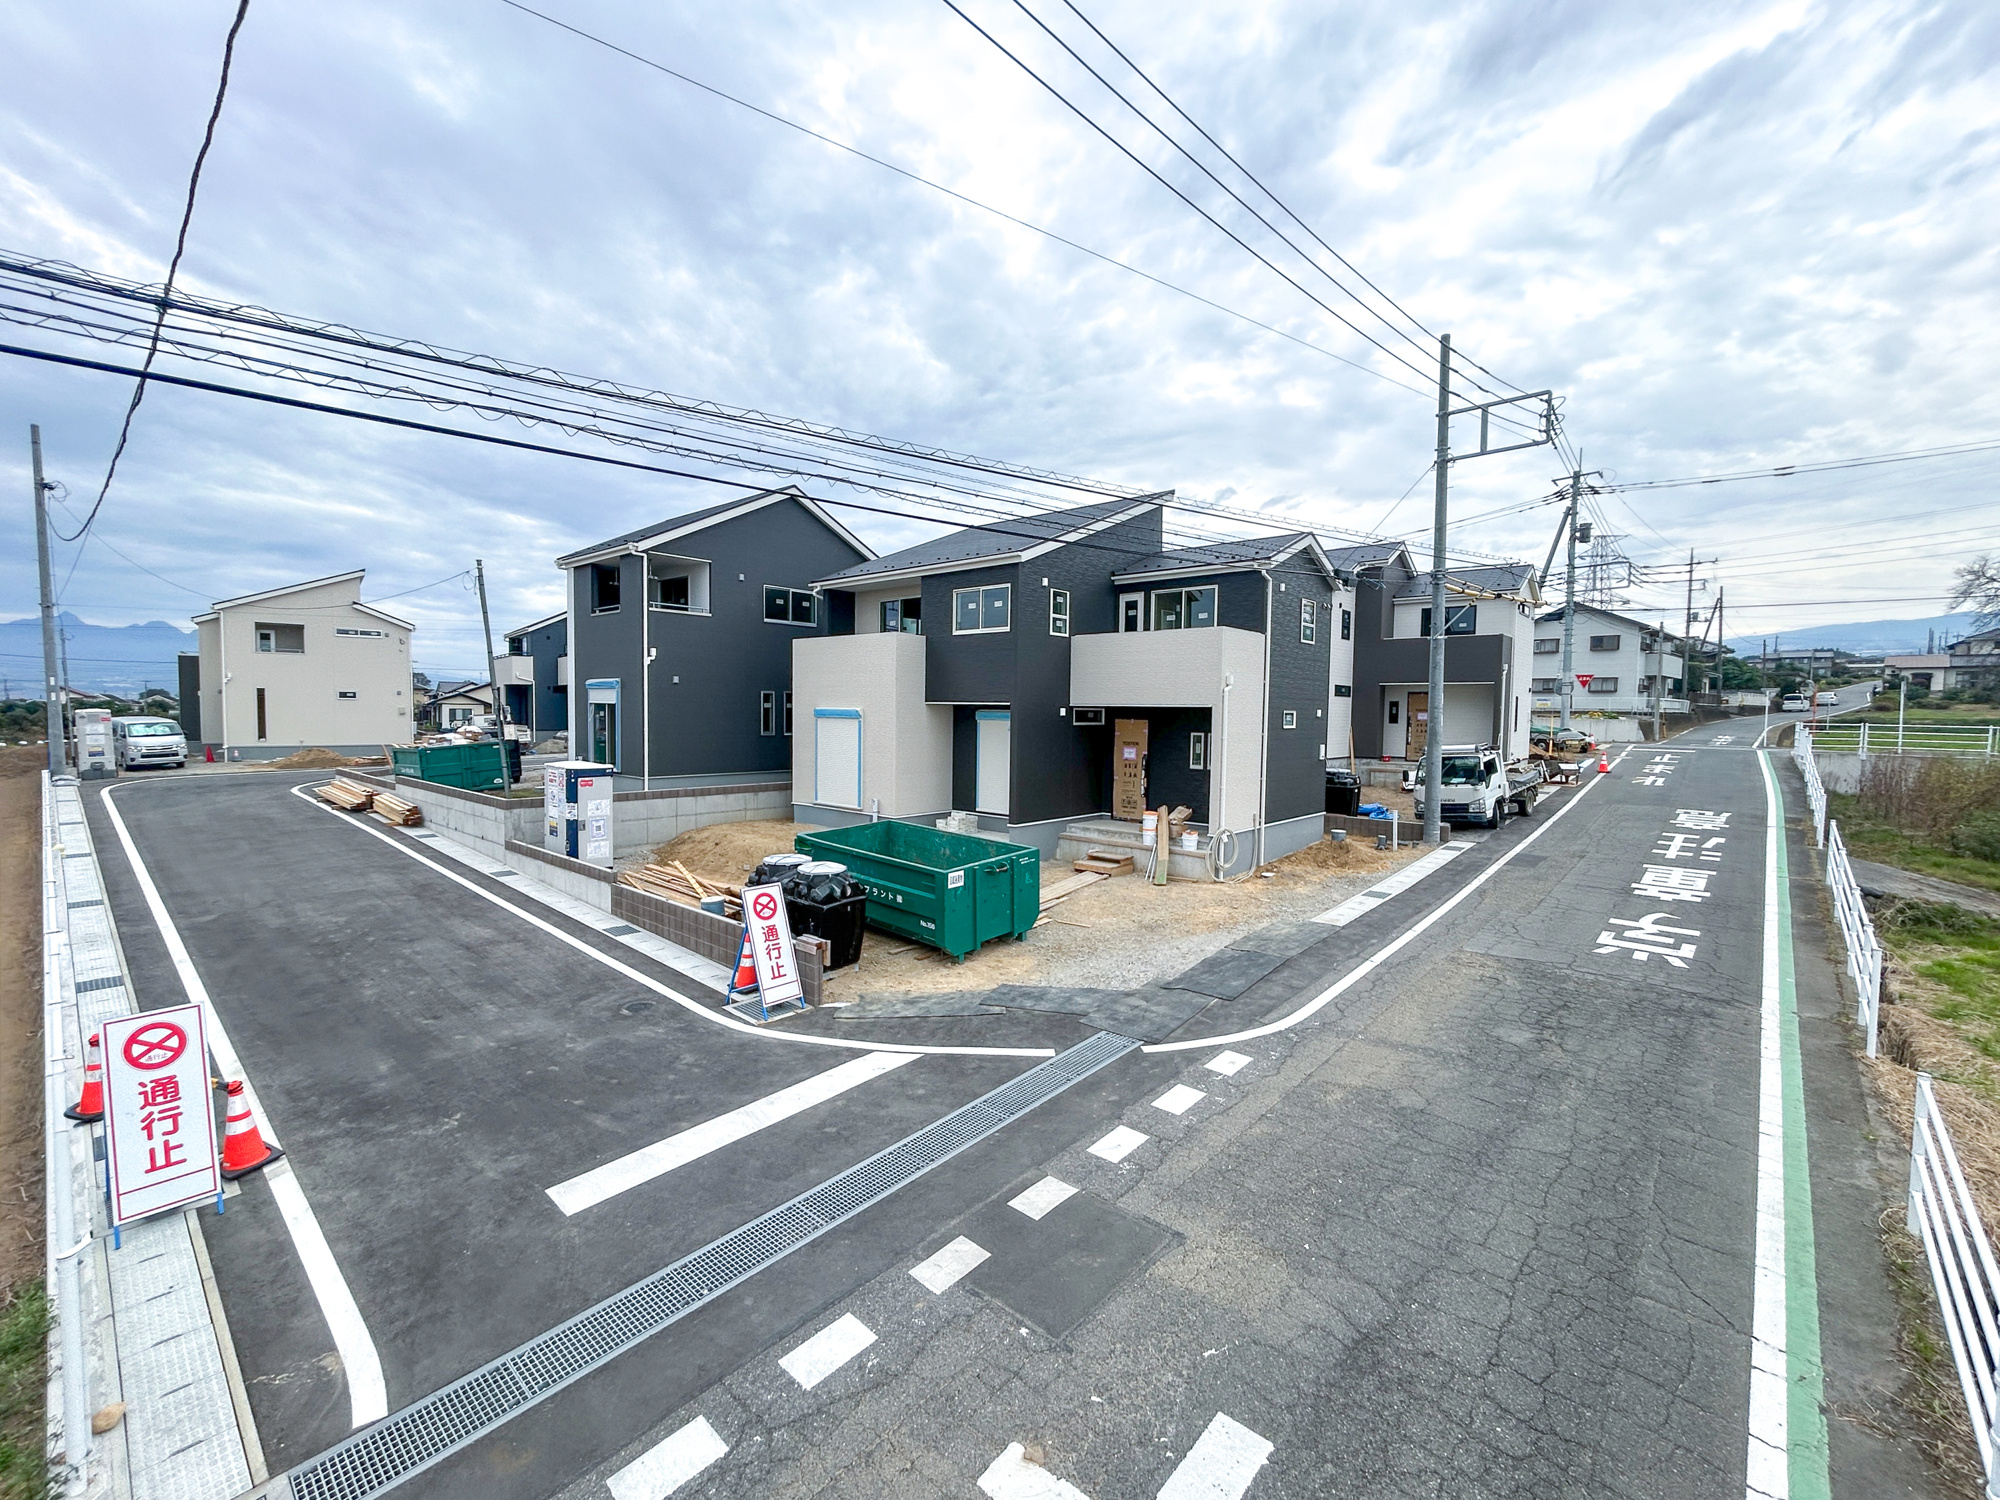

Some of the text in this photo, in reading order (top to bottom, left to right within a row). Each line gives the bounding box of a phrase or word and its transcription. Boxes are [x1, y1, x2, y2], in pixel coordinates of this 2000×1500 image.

[1631, 753, 1681, 786] 止まれ
[1591, 808, 1732, 969] 学童注意
[761, 924, 787, 980] 通行止
[145, 1052, 168, 1062] 通行止
[138, 1074, 188, 1174] 通行止
